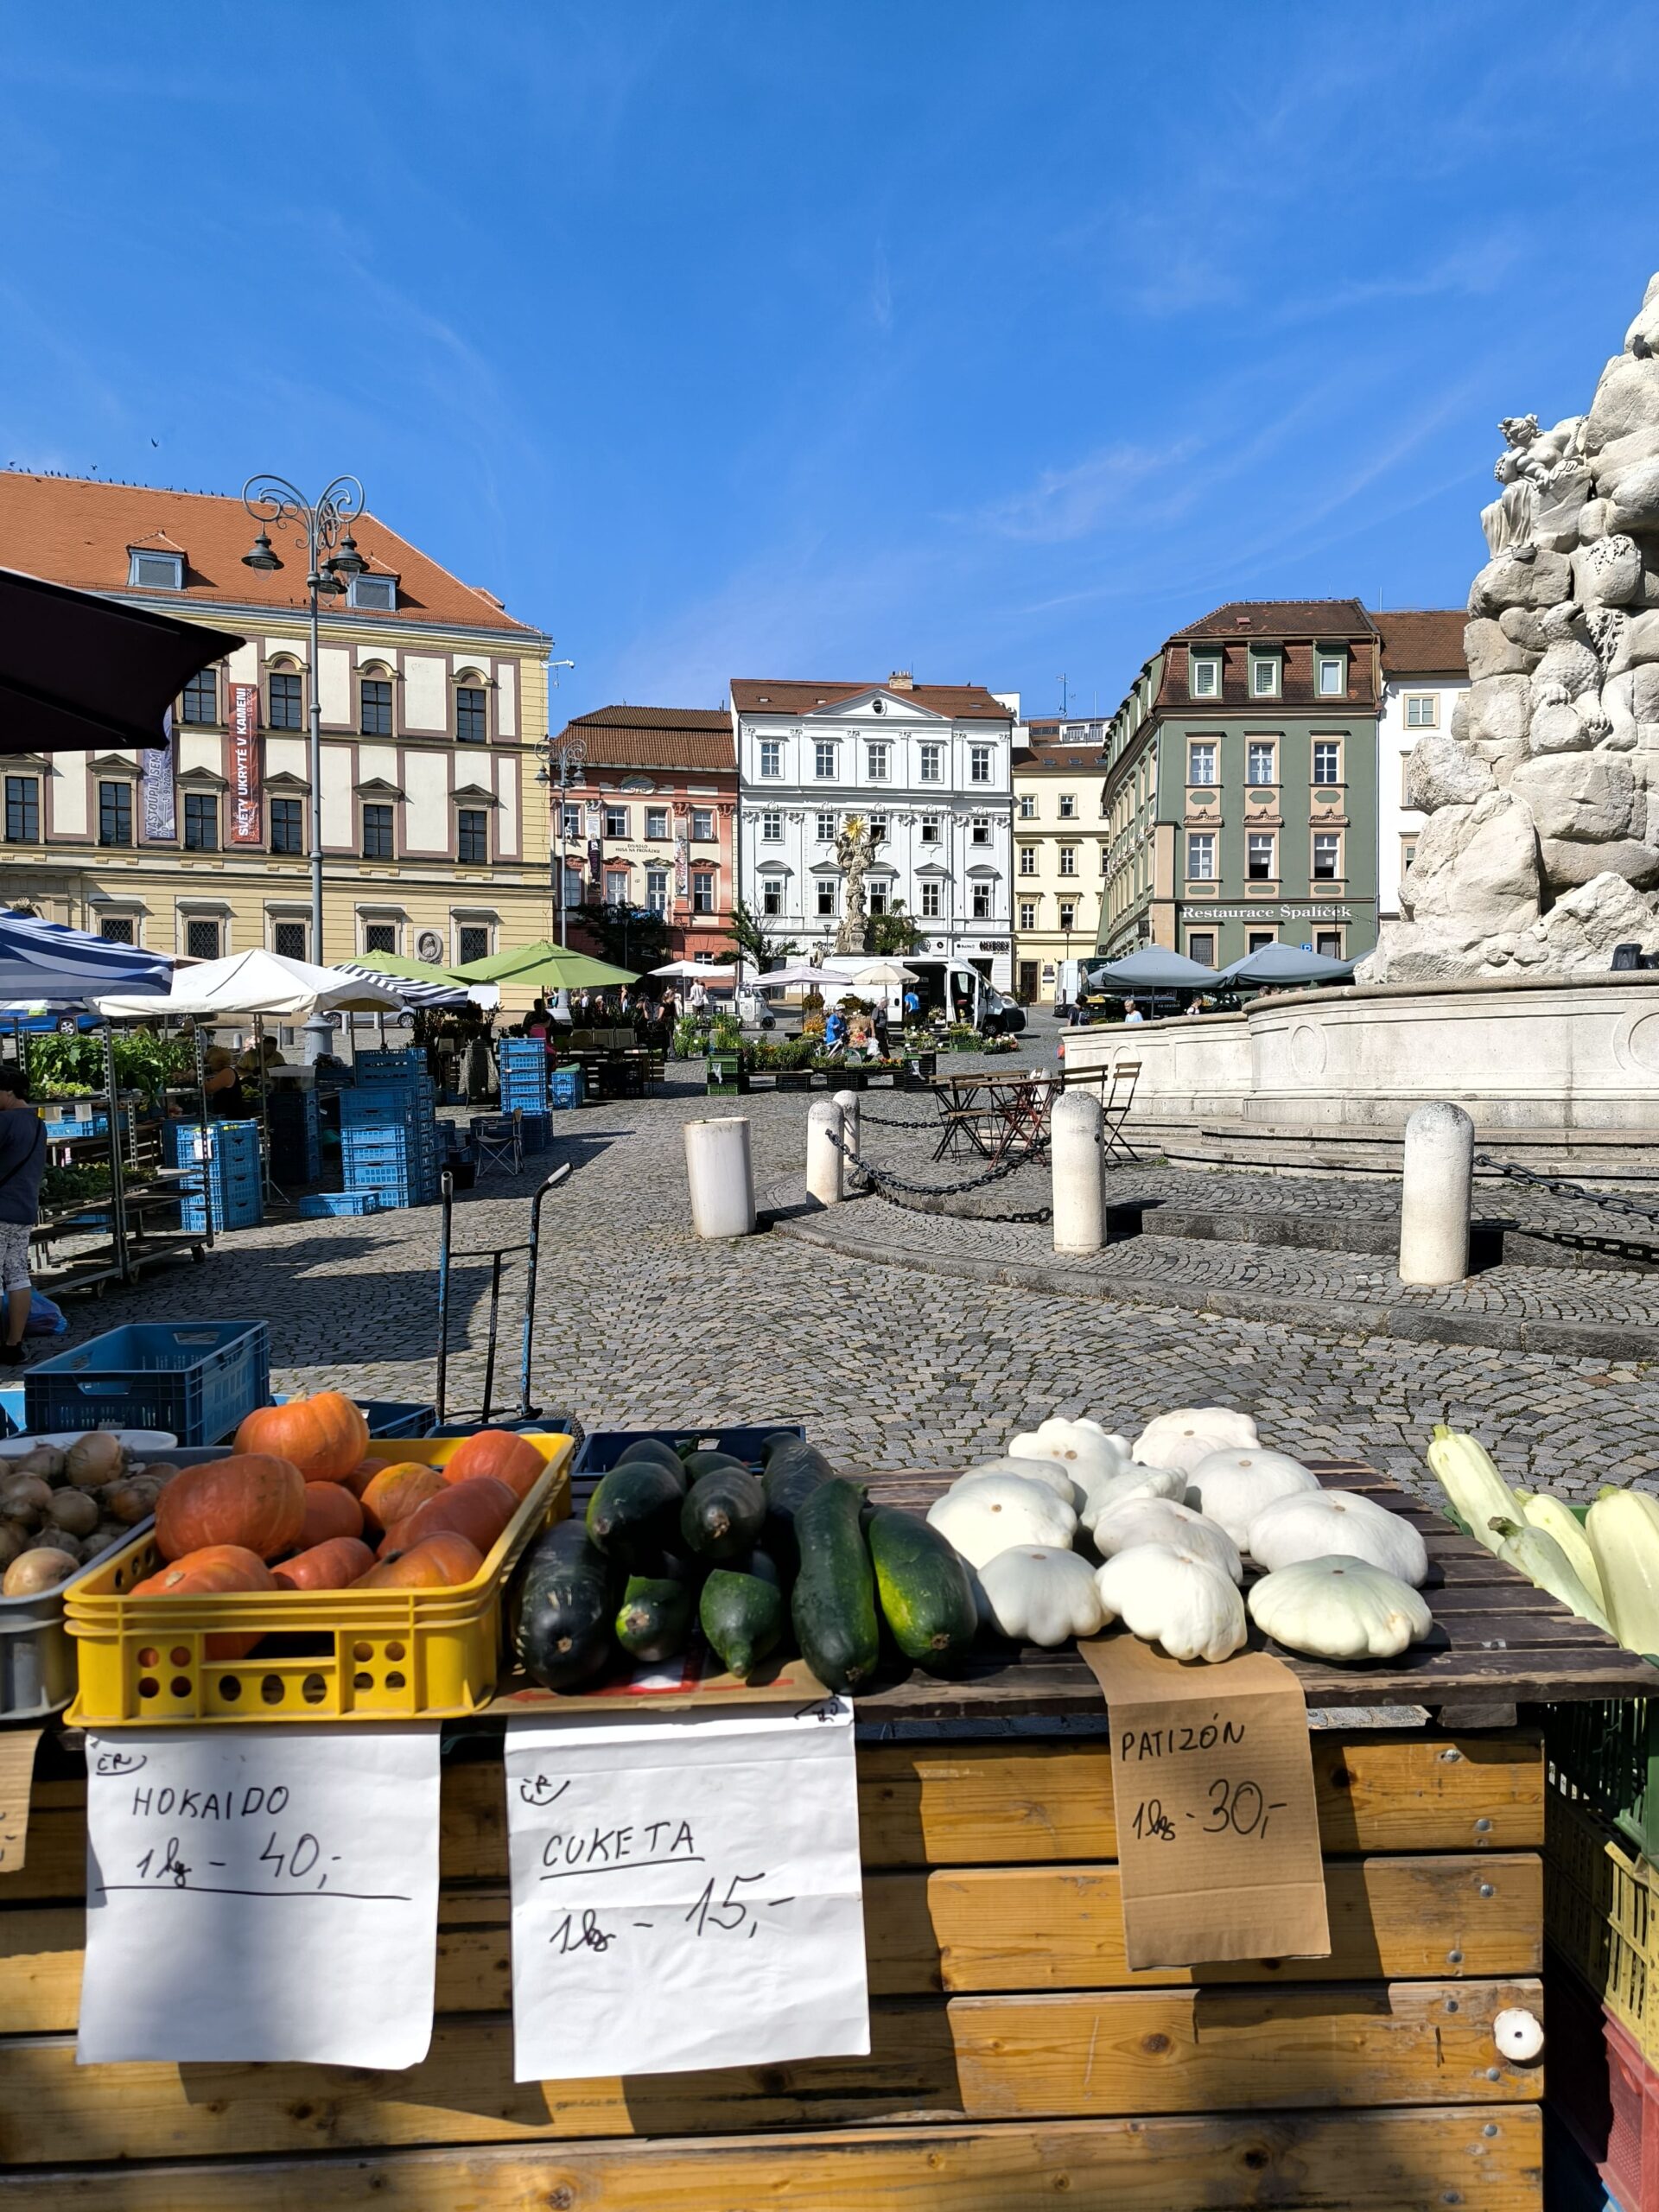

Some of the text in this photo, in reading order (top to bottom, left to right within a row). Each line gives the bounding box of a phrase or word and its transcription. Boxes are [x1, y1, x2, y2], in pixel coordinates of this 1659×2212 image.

[236, 688, 247, 734] KAMENI
[235, 749, 249, 796] UKRYTÉ
[235, 798, 249, 836] SVĚTY
[1182, 904, 1352, 919] Restaurace Špalíček
[1122, 1713, 1245, 1762] PATIZÓN
[132, 1786, 289, 1820] HOKAIDO
[1203, 1778, 1287, 1840] 30,-
[259, 1831, 342, 1890] 40,-
[543, 1821, 694, 1866] CUKETA
[685, 1872, 796, 1938] 15,-
